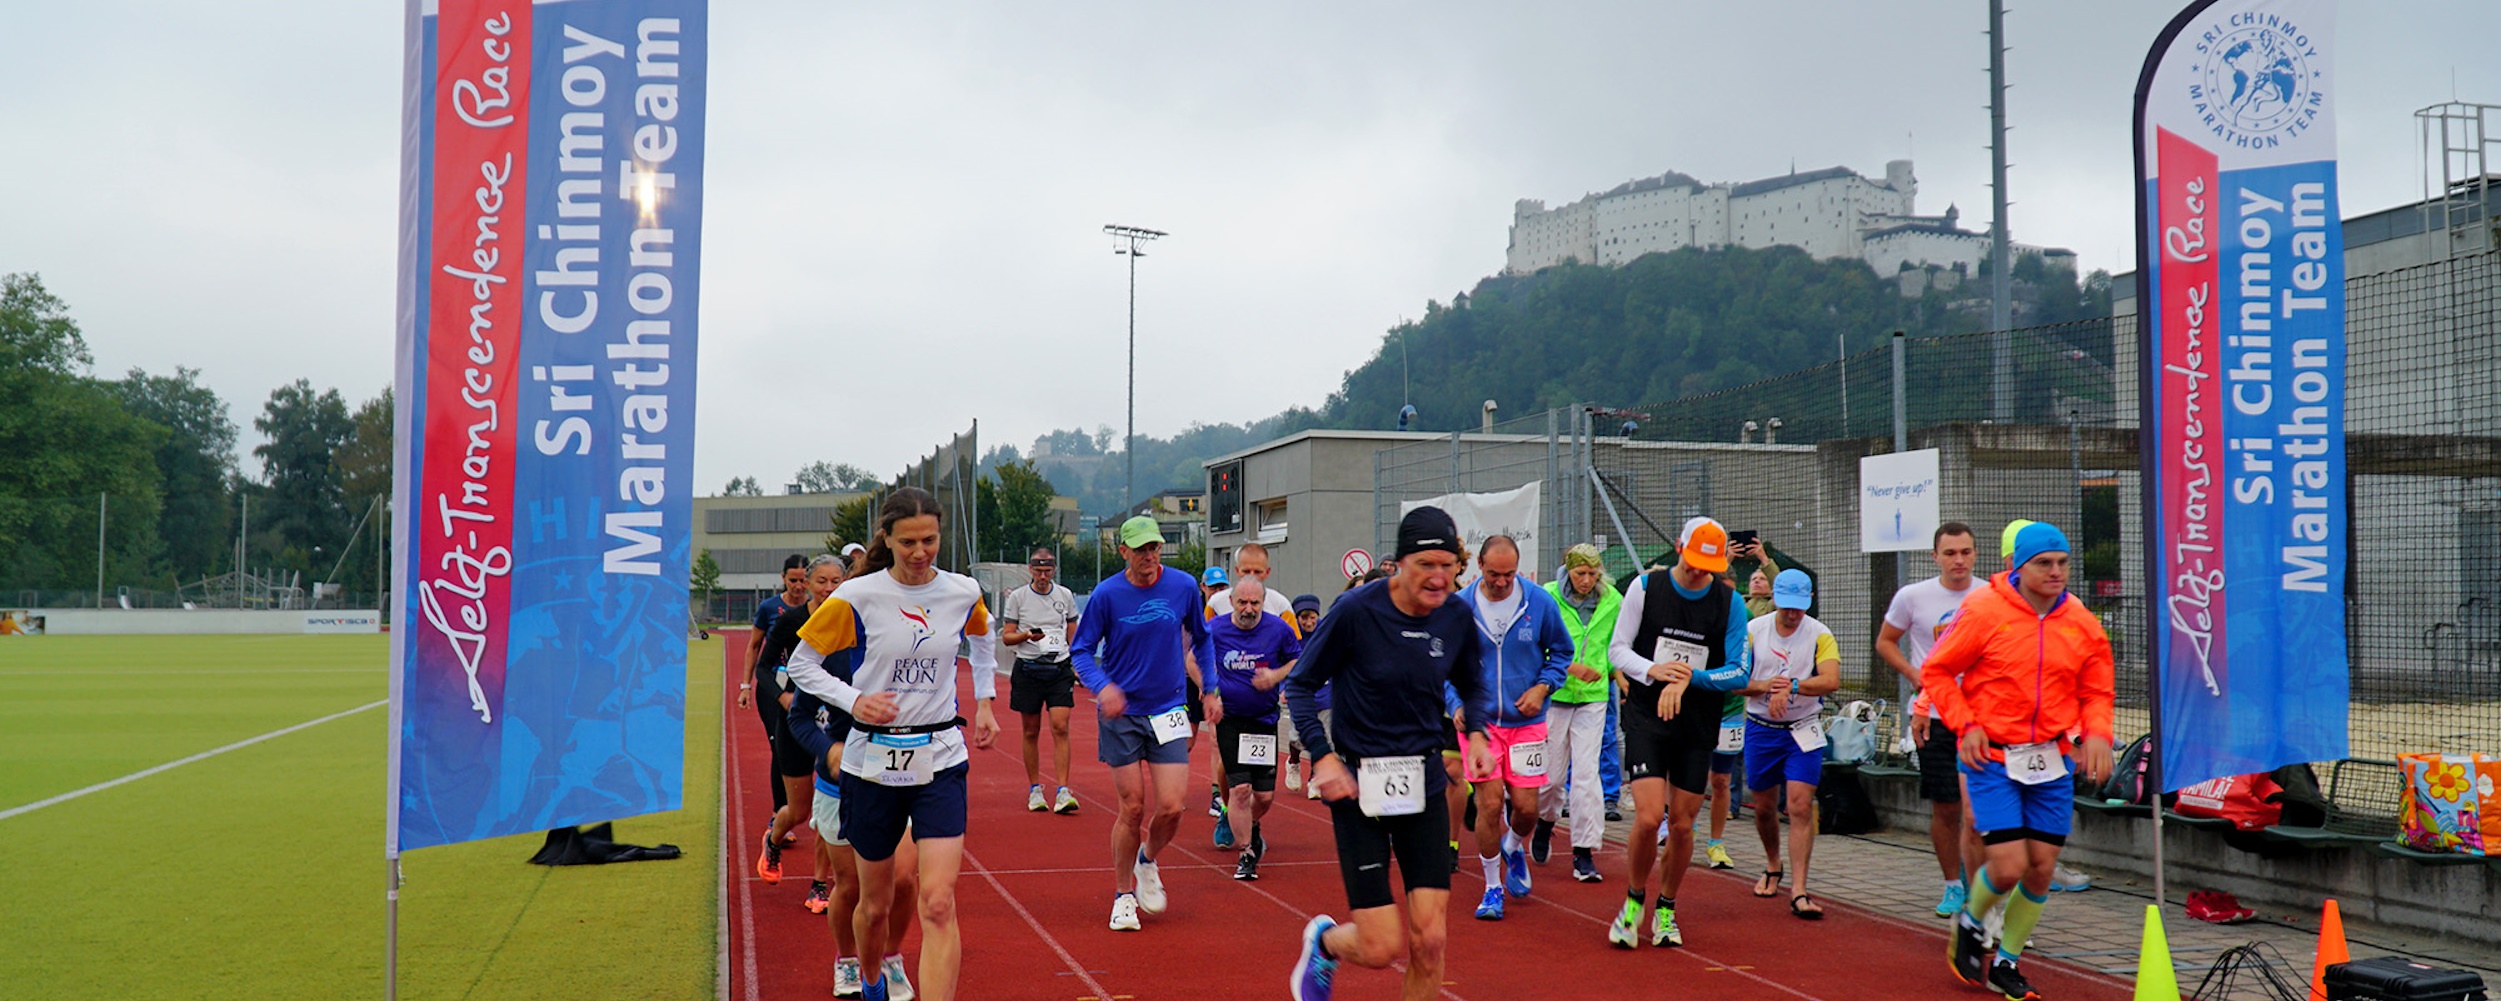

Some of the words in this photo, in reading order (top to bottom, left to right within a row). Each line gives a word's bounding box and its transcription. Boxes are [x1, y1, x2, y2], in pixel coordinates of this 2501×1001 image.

[2196, 24, 2223, 54] SRI
[2230, 12, 2317, 59] CHINMOY
[453, 11, 514, 128] Race
[619, 18, 680, 200] Team
[2190, 84, 2279, 149] MARATHON
[2286, 91, 2323, 138] TEAM
[535, 23, 625, 333] Chinmoy
[2166, 176, 2209, 262] Race
[2282, 182, 2328, 318] Team
[2229, 187, 2285, 416] Chinmoy
[533, 364, 594, 455] Sri
[603, 228, 674, 576] Marathon
[2229, 438, 2274, 505] Sri
[2278, 337, 2329, 593] Marathon
[1894, 481, 1911, 500] give
[1048, 634, 1060, 645] 26
[895, 658, 939, 669] PEACE
[1231, 660, 1255, 670] WORLD
[892, 669, 937, 684] RUN
[1165, 711, 1185, 728] 38
[1729, 728, 1742, 741] 15
[1811, 725, 1819, 738] 9
[885, 749, 915, 771] 17
[1251, 744, 1266, 757] 23
[1526, 753, 1542, 767] 40
[2028, 754, 2047, 772] 48
[1385, 774, 1410, 796] 63
